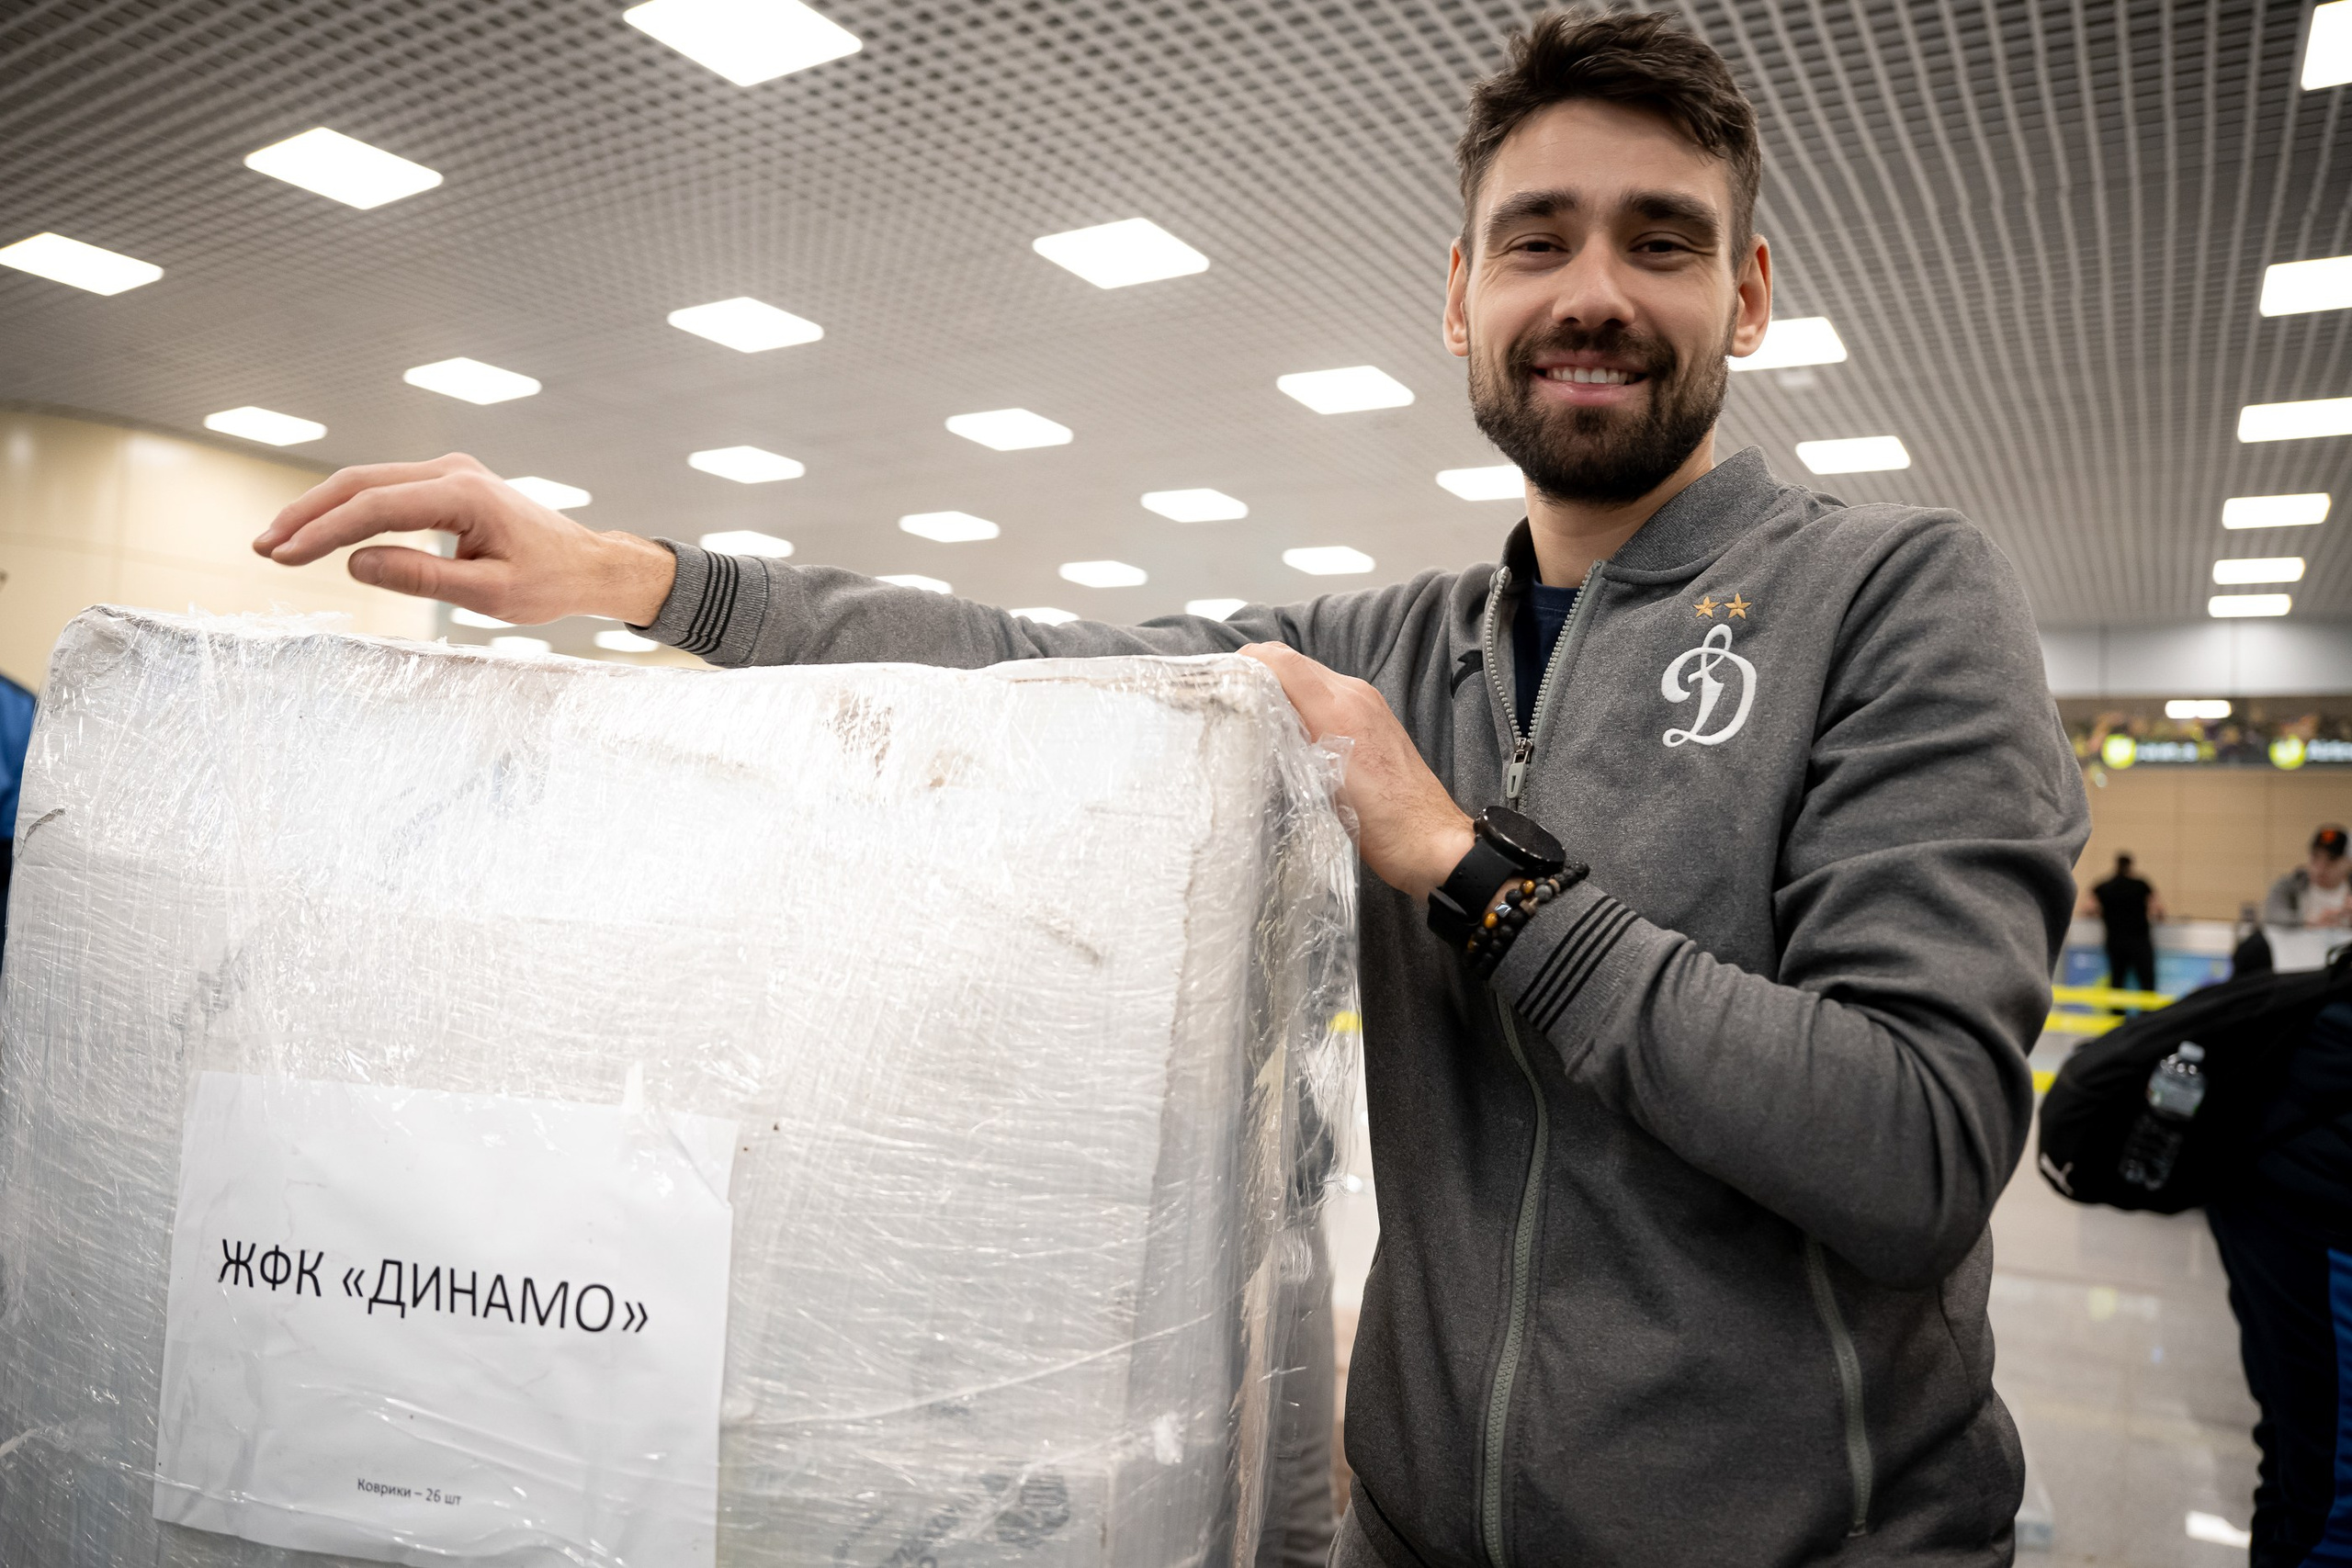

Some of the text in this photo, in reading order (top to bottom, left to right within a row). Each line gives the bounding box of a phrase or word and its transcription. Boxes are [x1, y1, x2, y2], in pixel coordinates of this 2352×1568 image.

[218, 1238, 649, 1333] ЖФК «ДИНАМО»
[356, 1478, 413, 1498] Коврики
[425, 1487, 442, 1504] 26
[445, 1494, 462, 1506] шт
